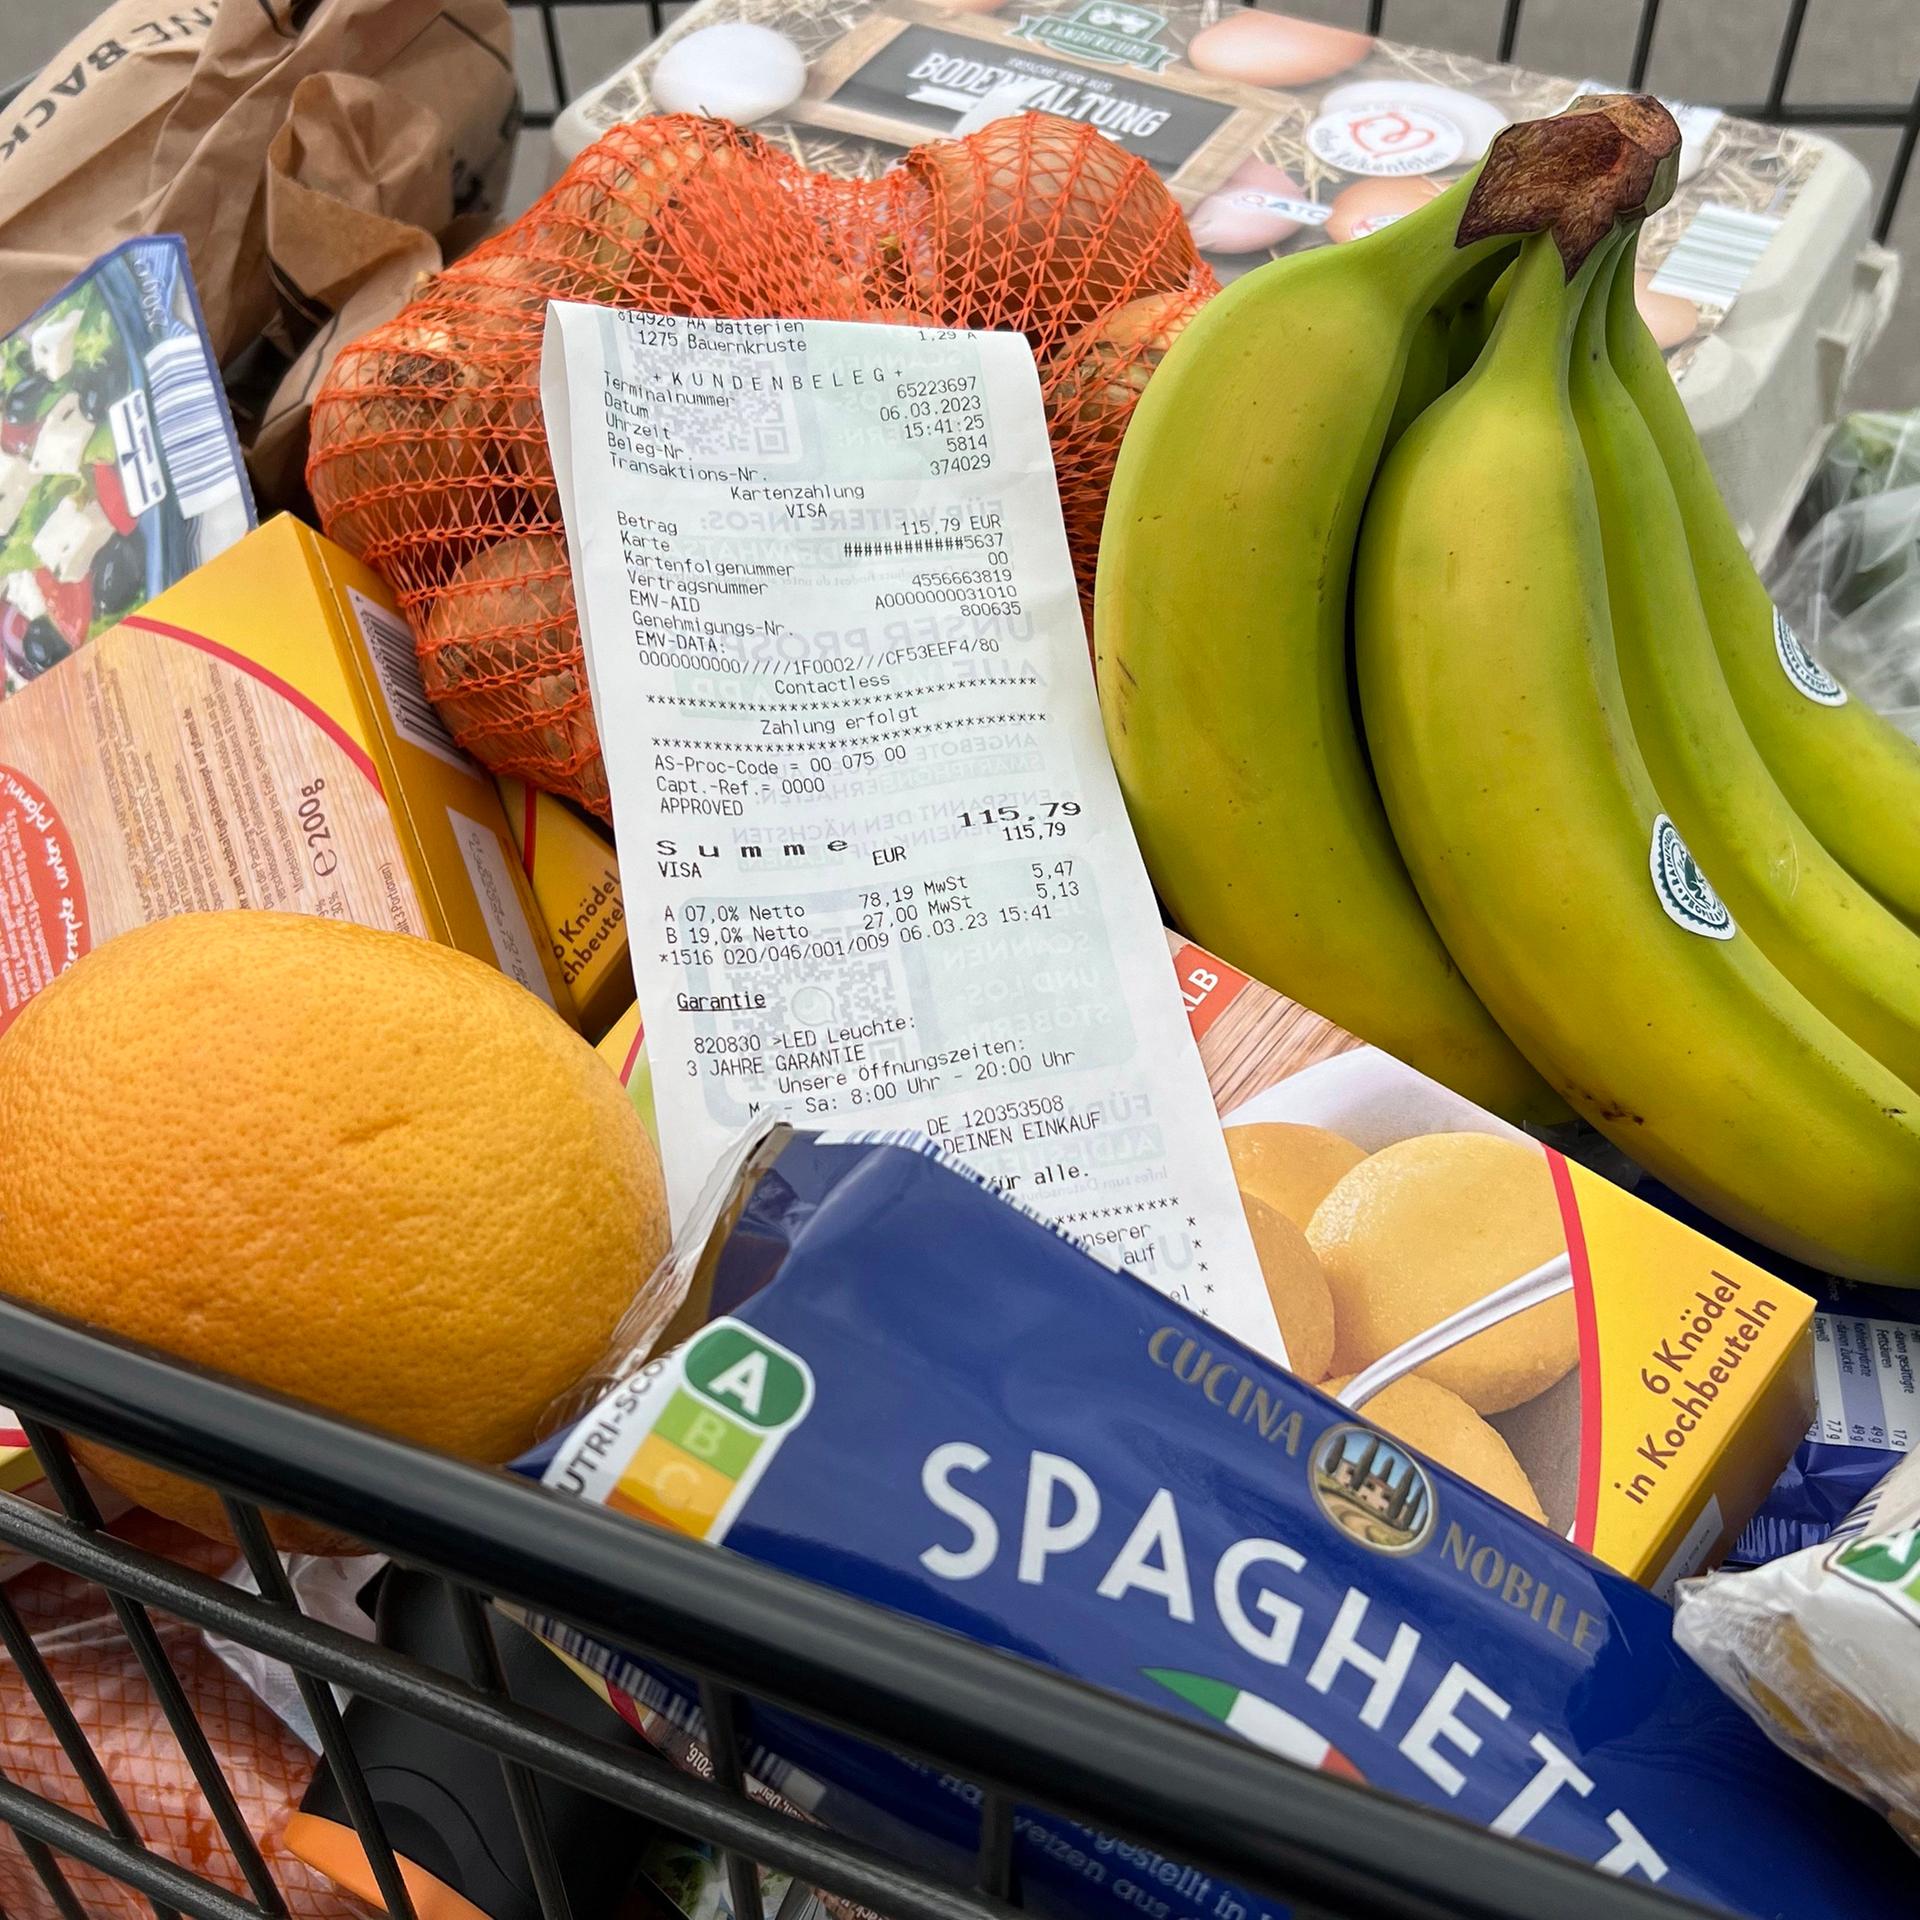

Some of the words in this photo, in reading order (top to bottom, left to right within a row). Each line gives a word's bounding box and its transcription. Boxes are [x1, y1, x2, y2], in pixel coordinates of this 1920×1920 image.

[0, 39, 128, 161] BACK
[638, 330, 678, 347] 1275
[687, 332, 807, 354] Bauernkruste
[715, 318, 805, 336] Batterien
[604, 370, 735, 408] Terminalnummer
[897, 376, 976, 399] 65223697
[605, 392, 649, 420] Datum
[880, 395, 981, 422] 06.03.2023
[606, 412, 671, 440] Uhrzeit
[904, 414, 985, 440] 15:41:25
[608, 431, 693, 461] Beleg-Nr.
[946, 434, 988, 453] 5814
[610, 452, 767, 483] Transaktions-Nr.
[929, 453, 991, 476] 374029
[730, 484, 865, 501] Kartenzahlung
[617, 510, 678, 536] Betrag
[970, 513, 1001, 530] EUR
[785, 503, 828, 519] VISA
[620, 530, 670, 552] Karte
[623, 549, 795, 577] Kartenfolgenummer
[988, 551, 1009, 566] 00
[627, 569, 768, 595] Vertragsnummer
[912, 569, 1012, 588] 4556663819
[629, 589, 700, 612] EMV-AID
[875, 585, 1017, 611] A0000000031010
[632, 610, 794, 637] Genehmigungs-Nr.
[960, 601, 1022, 617] 800635
[635, 630, 726, 654] EMV-DATA:
[774, 673, 890, 695] Contactless
[760, 719, 834, 735] Zahlung
[845, 705, 919, 730] erfolgt
[655, 754, 778, 775] AS-Proc-Code
[810, 757, 832, 772] 00
[842, 751, 875, 770] 075
[885, 745, 907, 761] 00
[782, 777, 824, 795] 0000
[660, 797, 743, 816] APPROVED
[658, 860, 702, 878] VISA
[872, 845, 907, 866] EUR
[1002, 821, 1066, 842] 115,79
[562, 870, 621, 943] Knödel
[665, 905, 675, 922] A
[685, 904, 740, 924] 07,0%
[749, 904, 805, 922] Netto
[859, 885, 914, 910] 78,19
[923, 875, 968, 896] MwSt
[1032, 860, 1074, 880] 5,47
[667, 927, 678, 944] B
[689, 927, 743, 946] 19,0%
[753, 925, 809, 943] Netto
[863, 904, 918, 931] 27,00
[928, 895, 972, 917] MwSt
[1036, 880, 1080, 900] 5,13
[724, 933, 889, 966] 020/046/001/009
[900, 911, 988, 943] 06.03.23
[1000, 904, 1052, 924] 15:41
[677, 990, 767, 1012] Garantie
[694, 1034, 761, 1054] 820830
[773, 1030, 817, 1050] >LED
[827, 1016, 916, 1044] Leuchte:
[686, 1059, 698, 1077] 3
[710, 1056, 764, 1077] JAHRE
[775, 1044, 867, 1072] GARANTIE
[778, 1072, 848, 1094] Unsere
[805, 1096, 838, 1114] Sa:
[850, 1083, 897, 1105] 8:00
[907, 1075, 940, 1095] Uhr
[975, 1054, 1032, 1081] 20:00
[1042, 1050, 1076, 1068] Uhr
[927, 1116, 951, 1137] DE
[964, 1095, 1065, 1130] 120353508
[942, 1127, 1014, 1155] DEINEN
[1024, 1110, 1101, 1141] EINKAUF
[1035, 1163, 1090, 1185] alle.
[1123, 1245, 1156, 1265] auf
[1652, 1269, 1742, 1374] Knödel
[707, 1349, 769, 1418] A
[1641, 1367, 1671, 1395] 6
[1613, 1475, 1656, 1505] in
[1636, 1296, 1778, 1471] Kochbeuteln
[556, 1352, 674, 1498] UTRI-SCO
[682, 1411, 727, 1458] B
[1826, 1417, 1842, 1432] 7,7
[1851, 1423, 1864, 1434] 49
[1869, 1424, 1883, 1435] 49
[655, 1462, 699, 1508] C
[1147, 1326, 1306, 1456] CUCINA
[1438, 1521, 1604, 1655] NOBILE
